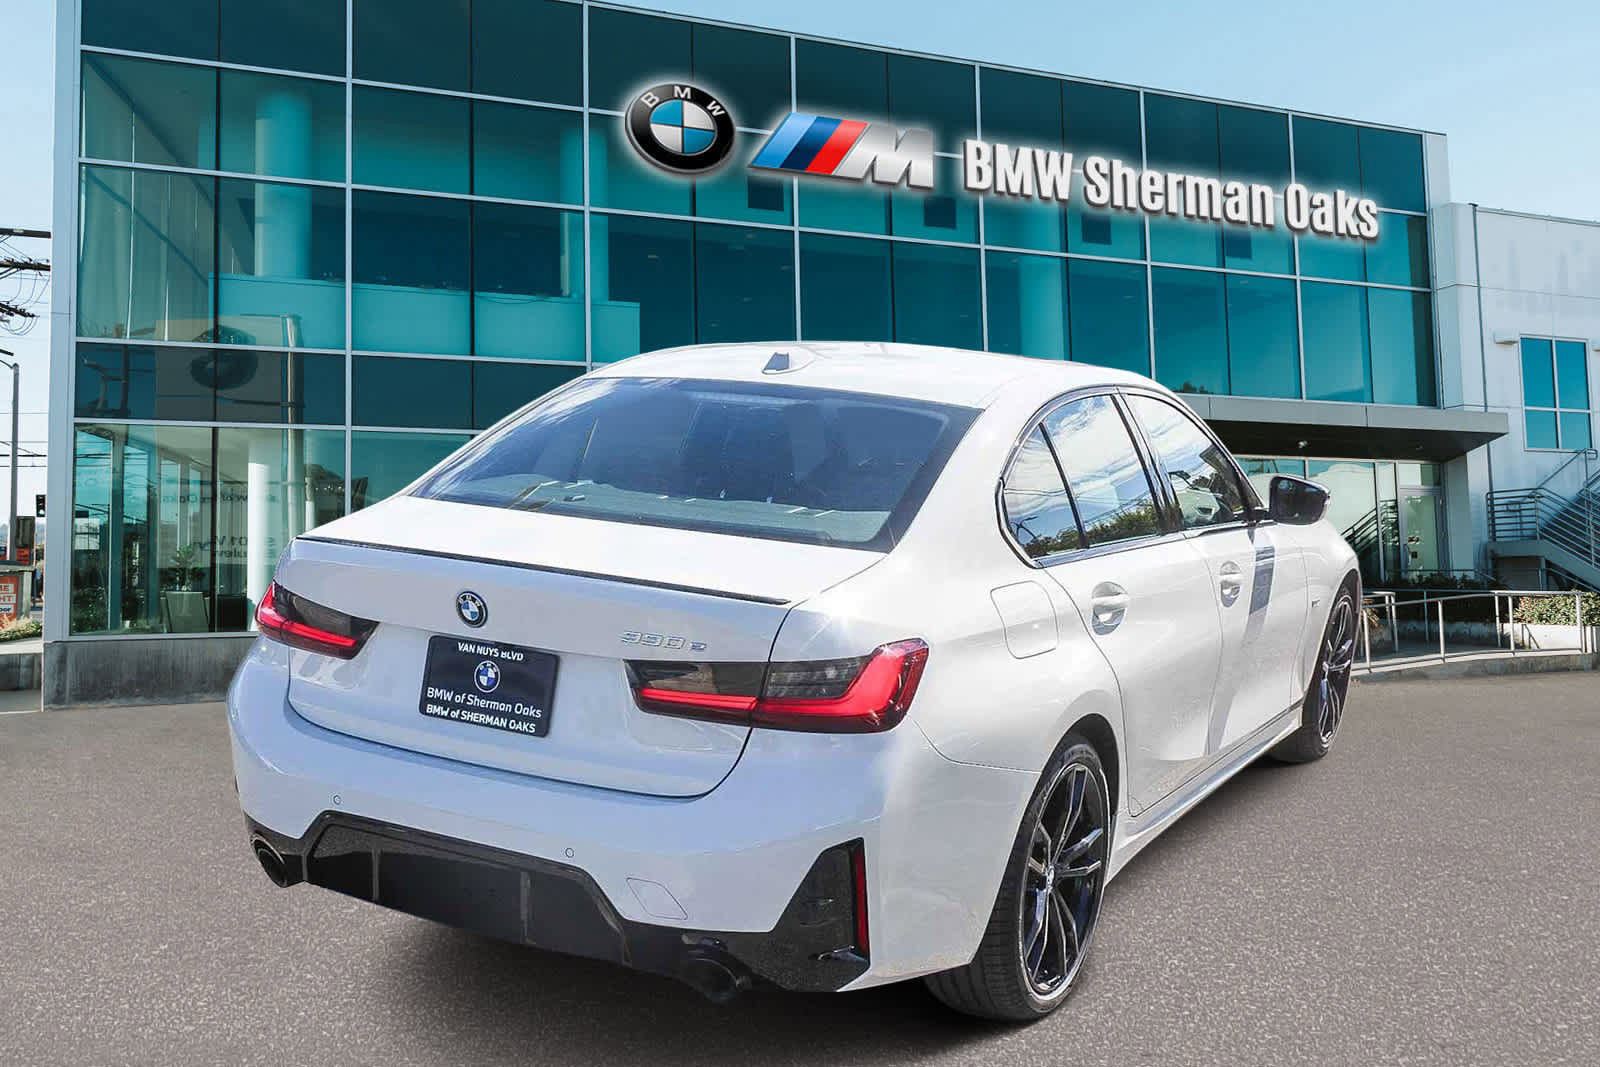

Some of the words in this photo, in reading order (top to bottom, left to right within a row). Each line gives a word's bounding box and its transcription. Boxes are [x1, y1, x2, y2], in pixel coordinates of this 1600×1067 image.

[640, 84, 726, 118] BMW
[963, 138, 1074, 202] BMW
[1082, 154, 1276, 228] Sherman
[1283, 182, 1380, 241] Oaks
[457, 642, 476, 654] VAN
[476, 645, 499, 657] NUYS
[500, 650, 524, 661] BLVD
[426, 686, 454, 702] BMW
[454, 693, 466, 703] of
[466, 694, 512, 713] Sherman
[514, 703, 543, 718] Oaks
[426, 703, 451, 717] BMW
[450, 709, 461, 719] of
[460, 711, 508, 729] SHERMAN
[508, 719, 537, 733] OAKS
